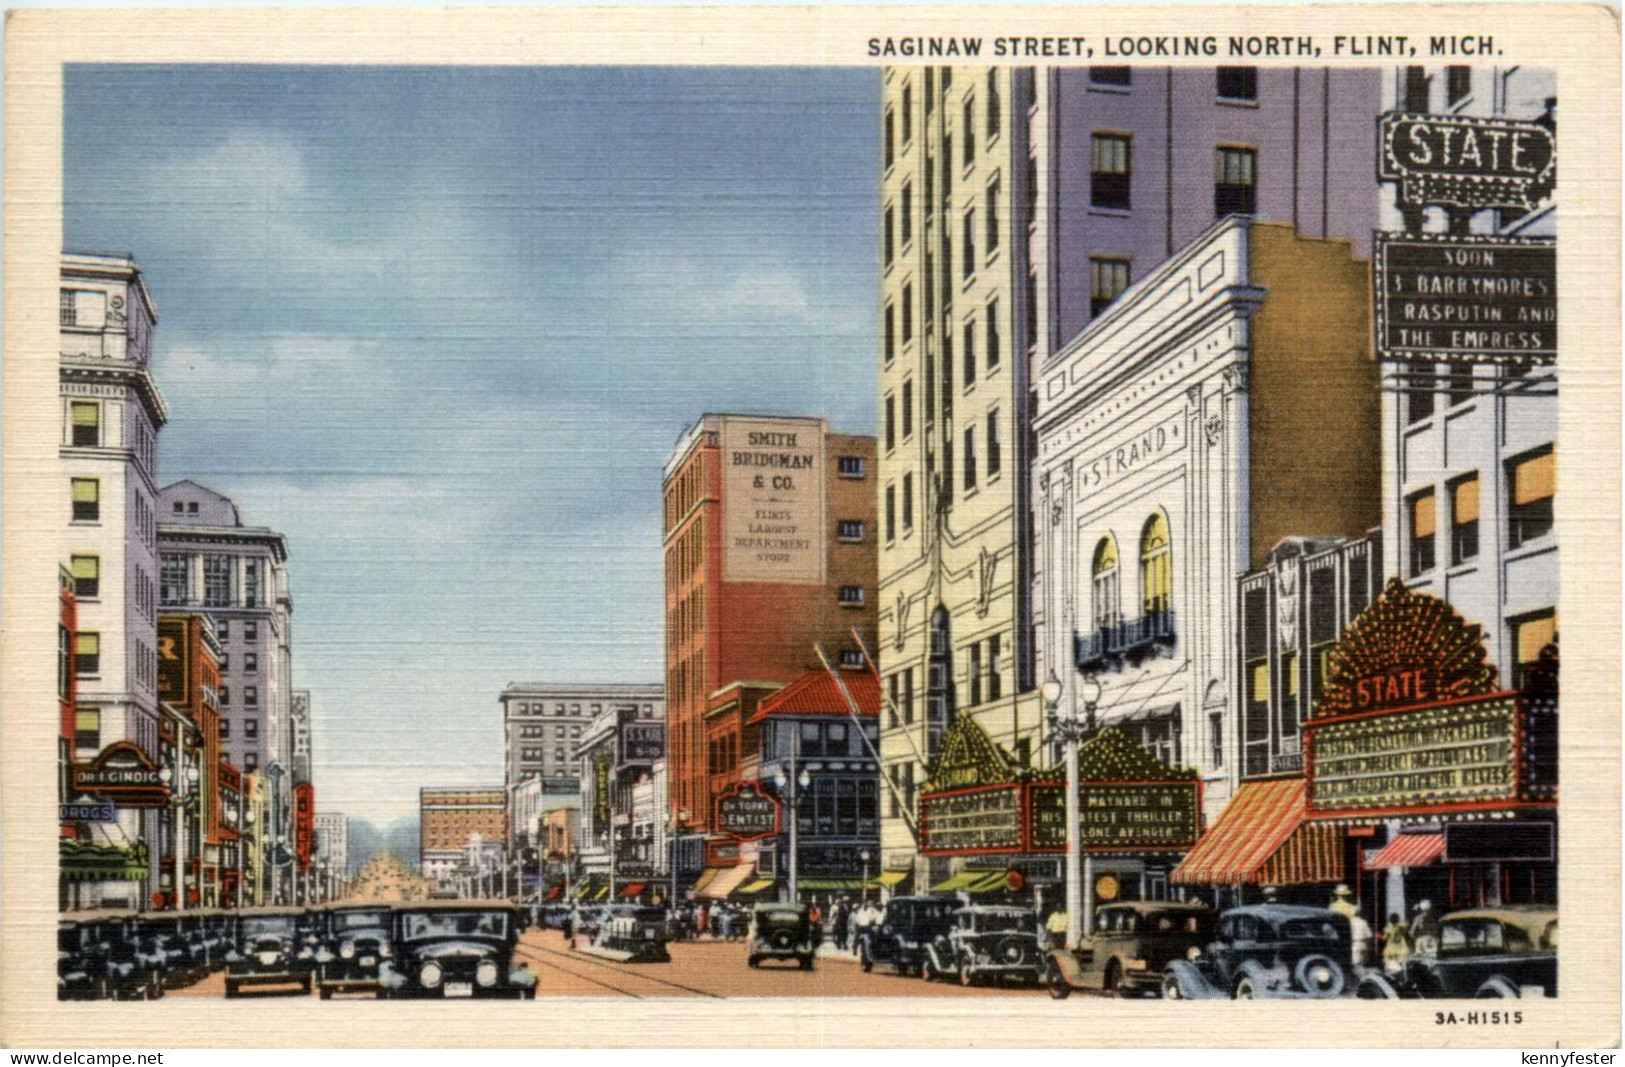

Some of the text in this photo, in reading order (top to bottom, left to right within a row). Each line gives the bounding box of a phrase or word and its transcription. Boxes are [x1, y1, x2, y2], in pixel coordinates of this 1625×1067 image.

[1408, 122, 1537, 173] STATE
[1445, 250, 1495, 267] SOON
[1416, 275, 1549, 297] BARRYMORES
[1404, 303, 1557, 322] RASPUTIN AND
[1400, 329, 1543, 349] THE EMPRESS
[747, 431, 797, 447] SMITH
[732, 451, 814, 469] BRIDGMAN
[1092, 427, 1166, 486] STRAND
[752, 475, 796, 490] & CO.
[748, 523, 798, 534] LARGEST
[734, 537, 810, 550] DEPARTMENT
[1357, 669, 1429, 706] STATE
[739, 801, 769, 811] YORKE
[1088, 796, 1147, 807] MAYNARD
[1160, 796, 1172, 806] IN
[60, 806, 112, 819] DRUGS
[720, 814, 775, 826] DENTIST
[1041, 811, 1182, 824] HIS ATEST THRILLER
